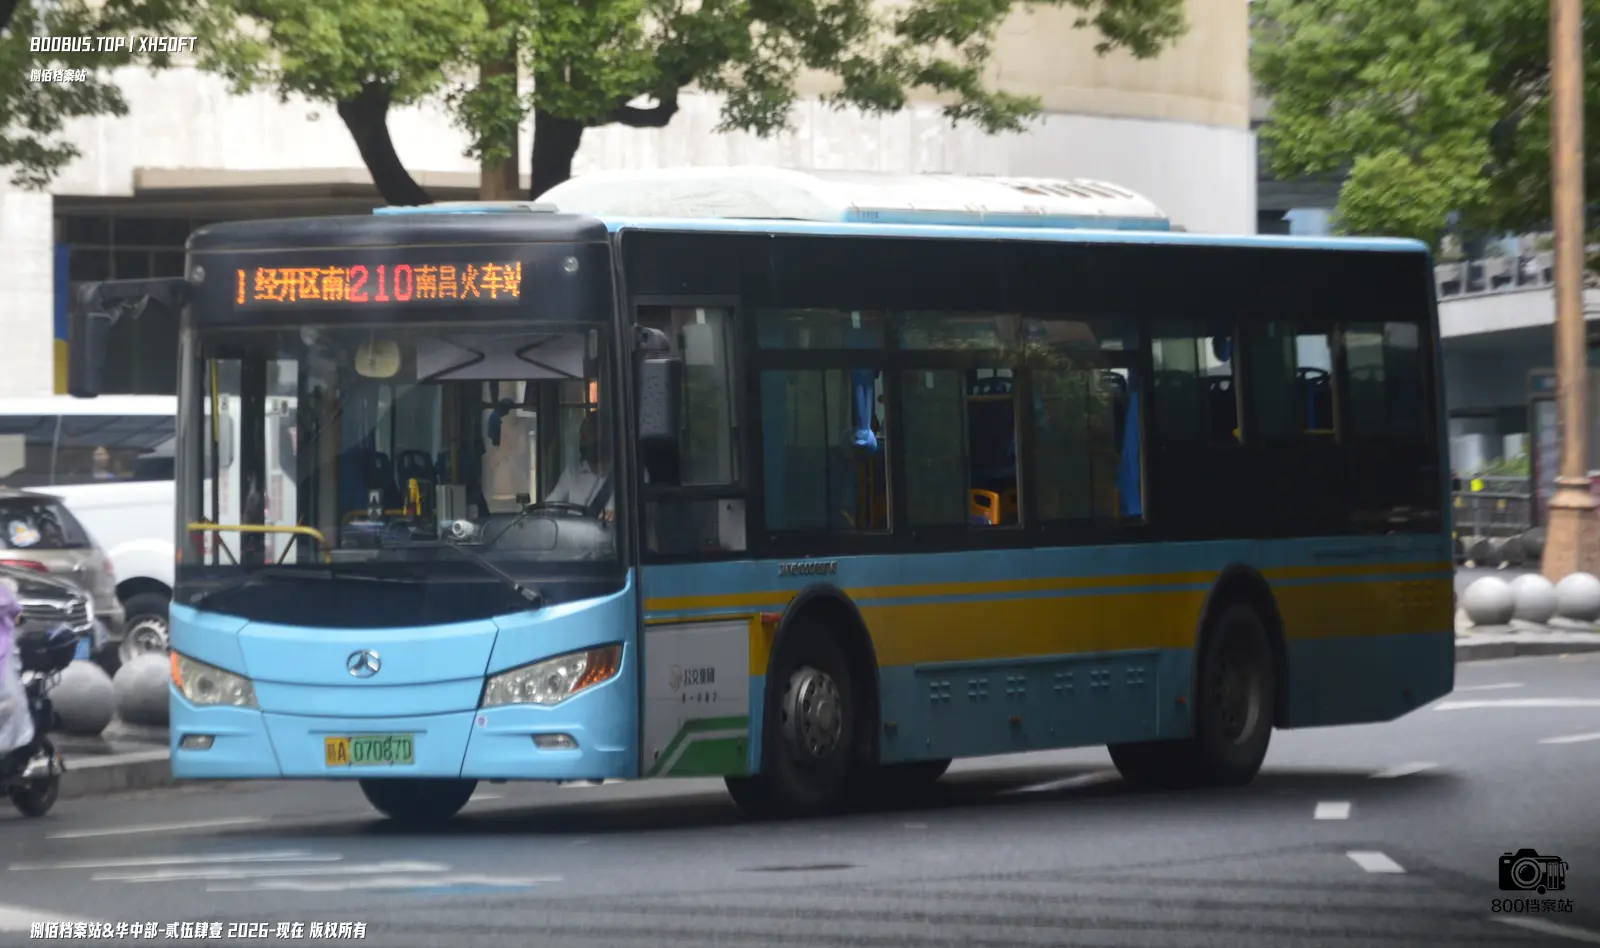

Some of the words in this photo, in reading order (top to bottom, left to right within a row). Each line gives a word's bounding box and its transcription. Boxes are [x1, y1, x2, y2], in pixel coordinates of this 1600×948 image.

[254, 266, 350, 302] 经开区南
[350, 264, 413, 302] 210
